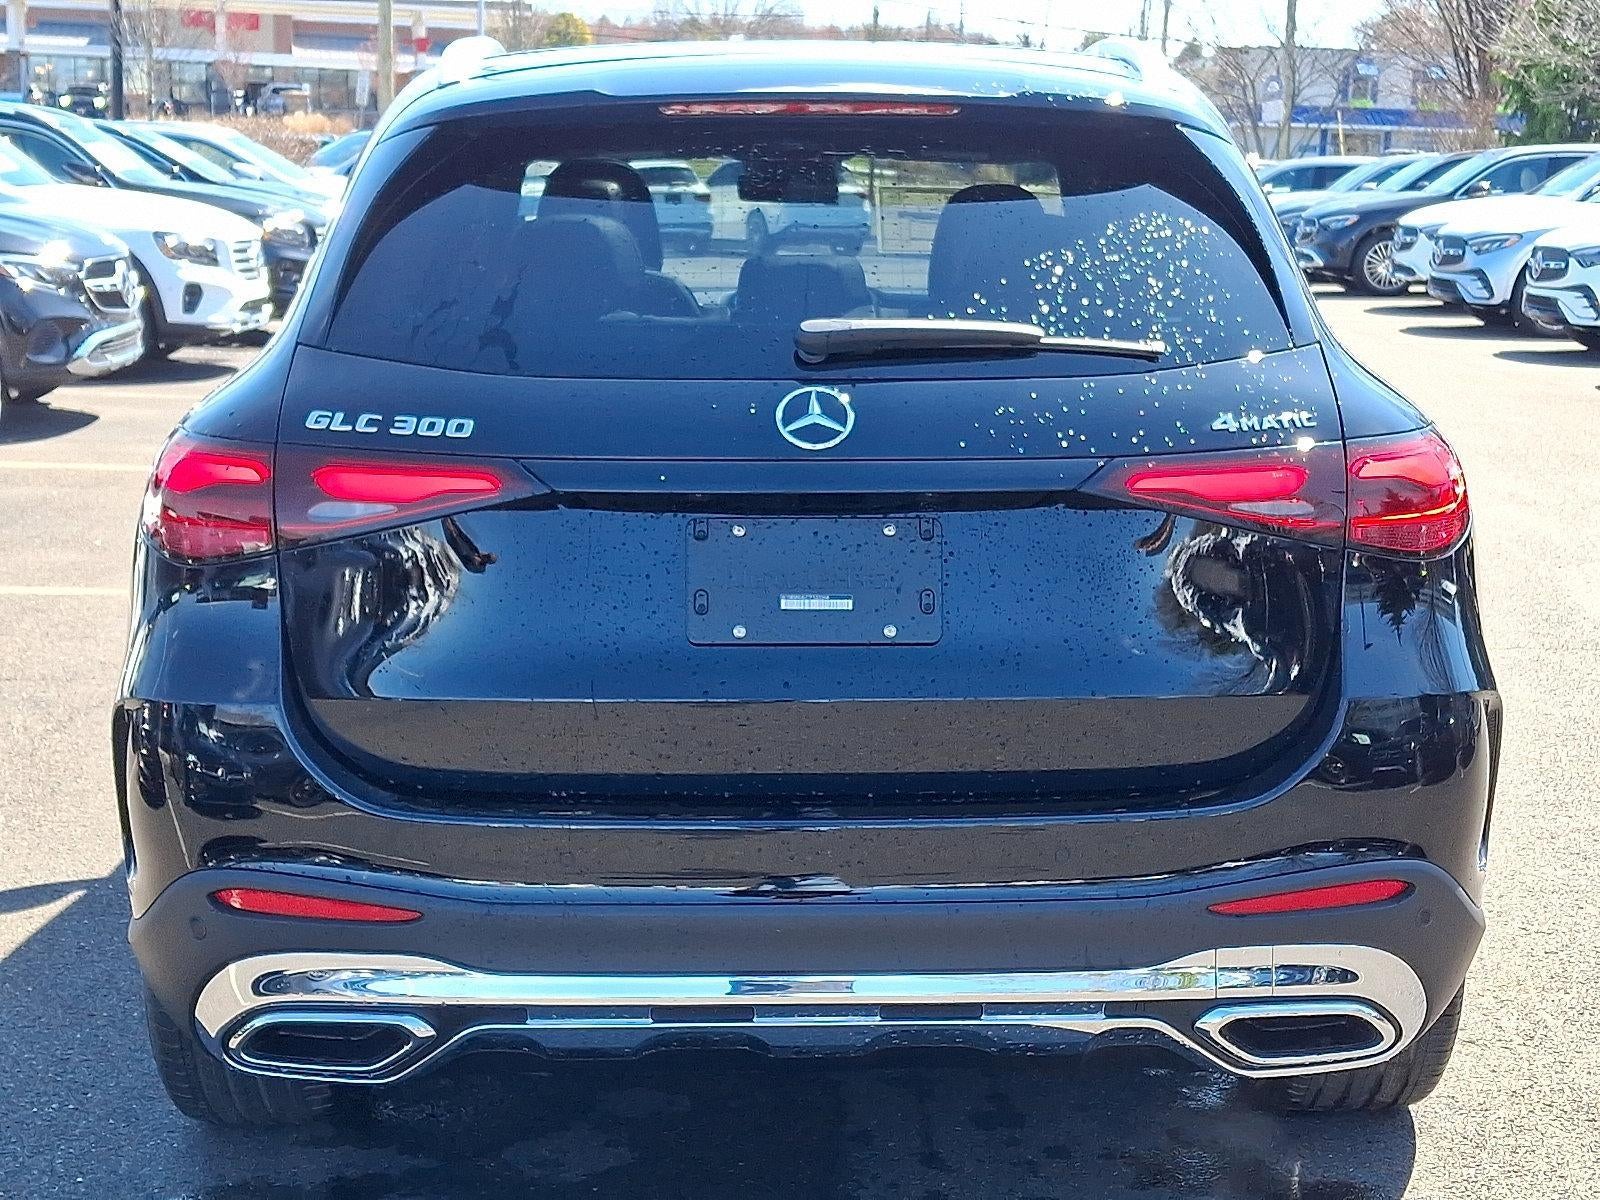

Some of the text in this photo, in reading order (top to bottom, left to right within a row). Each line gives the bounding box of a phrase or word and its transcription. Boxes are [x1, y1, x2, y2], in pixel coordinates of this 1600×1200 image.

[305, 410, 474, 438] GLC 300
[1211, 411, 1318, 432] 4MATIC
